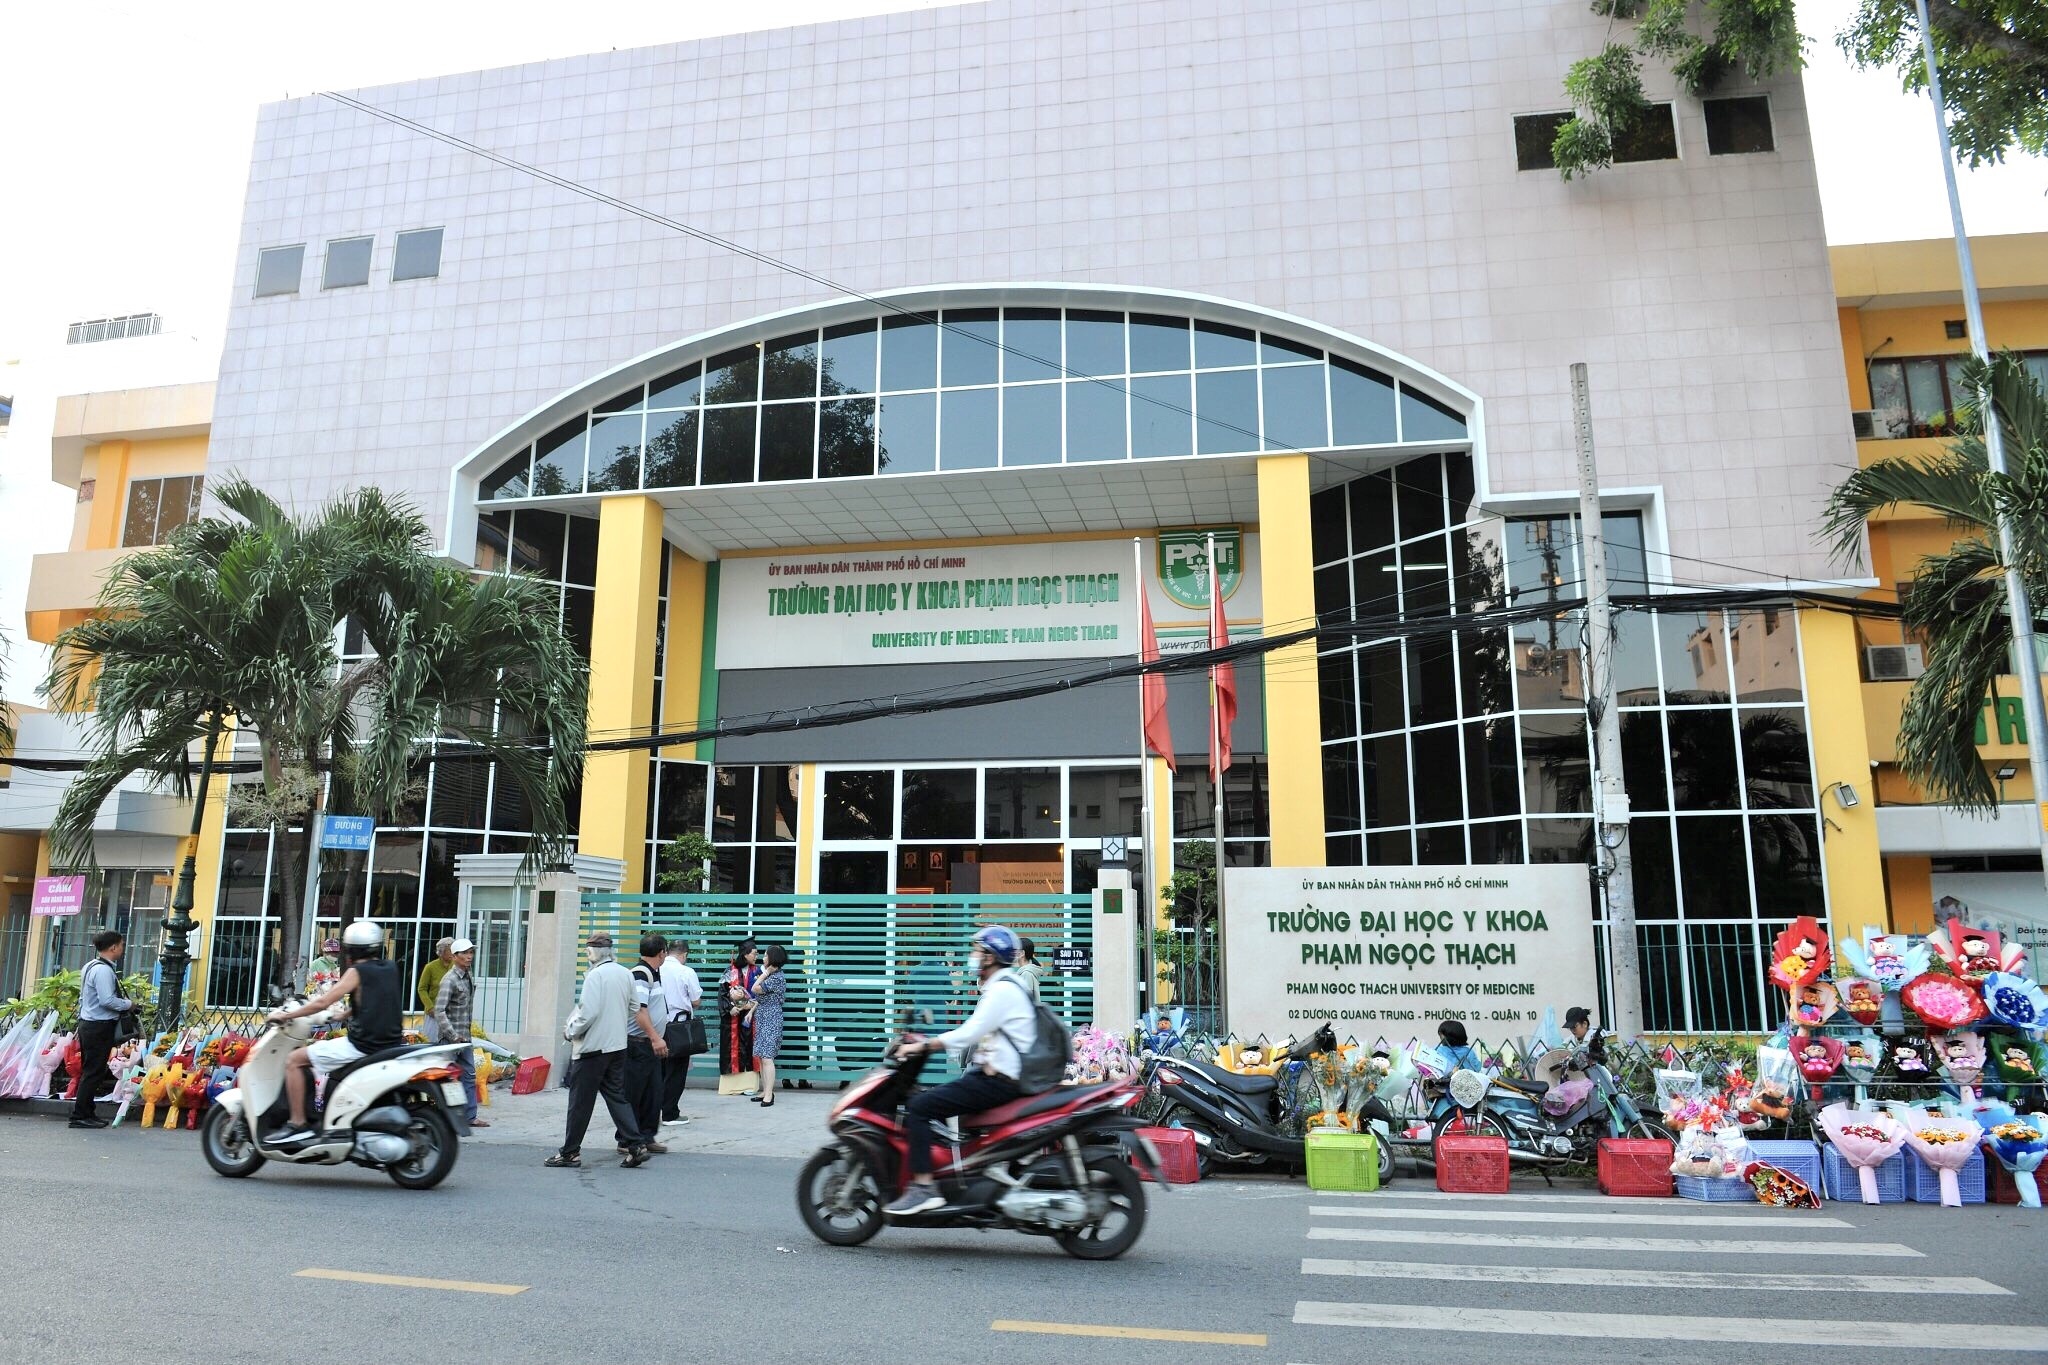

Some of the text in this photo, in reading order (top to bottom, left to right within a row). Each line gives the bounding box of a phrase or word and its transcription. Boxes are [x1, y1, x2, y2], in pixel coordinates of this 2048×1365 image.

[769, 555, 966, 576] ỦY BAN NHÂN DÂN THÀNH PHỐ HỒ CHÍ MINH
[1166, 541, 1233, 566] PNT
[768, 573, 1119, 617] TRƯỜNG ĐẠI HỌC Y KHOA PHẠM NGỌC THẠCH
[872, 624, 1119, 648] UNIVERSITY OF MEDICINE PHAM NGOC THACH
[1302, 875, 1509, 890] ỦY BAN NHÂN DÂN THÀNH PHỐ HỒ CHÍ MINH
[1266, 903, 1549, 938] TRƯỜNG ĐẠI HỌC Y KHOA
[1301, 943, 1516, 971] PHẠM NGỌC THẠCH
[1286, 983, 1535, 995] PHAM NGOC THACH UNIVERSITY OF MEDICINE
[1288, 1009, 1300, 1019] 02
[1302, 1008, 1338, 1020] DƯƠNG
[1340, 1009, 1377, 1020] QUANG
[1380, 1010, 1415, 1021] TRUNG
[1424, 1007, 1467, 1021] PHƯỜNG
[1470, 1011, 1481, 1021] 12
[1491, 1008, 1521, 1023] QUẬN
[1526, 1011, 1537, 1021] 10
